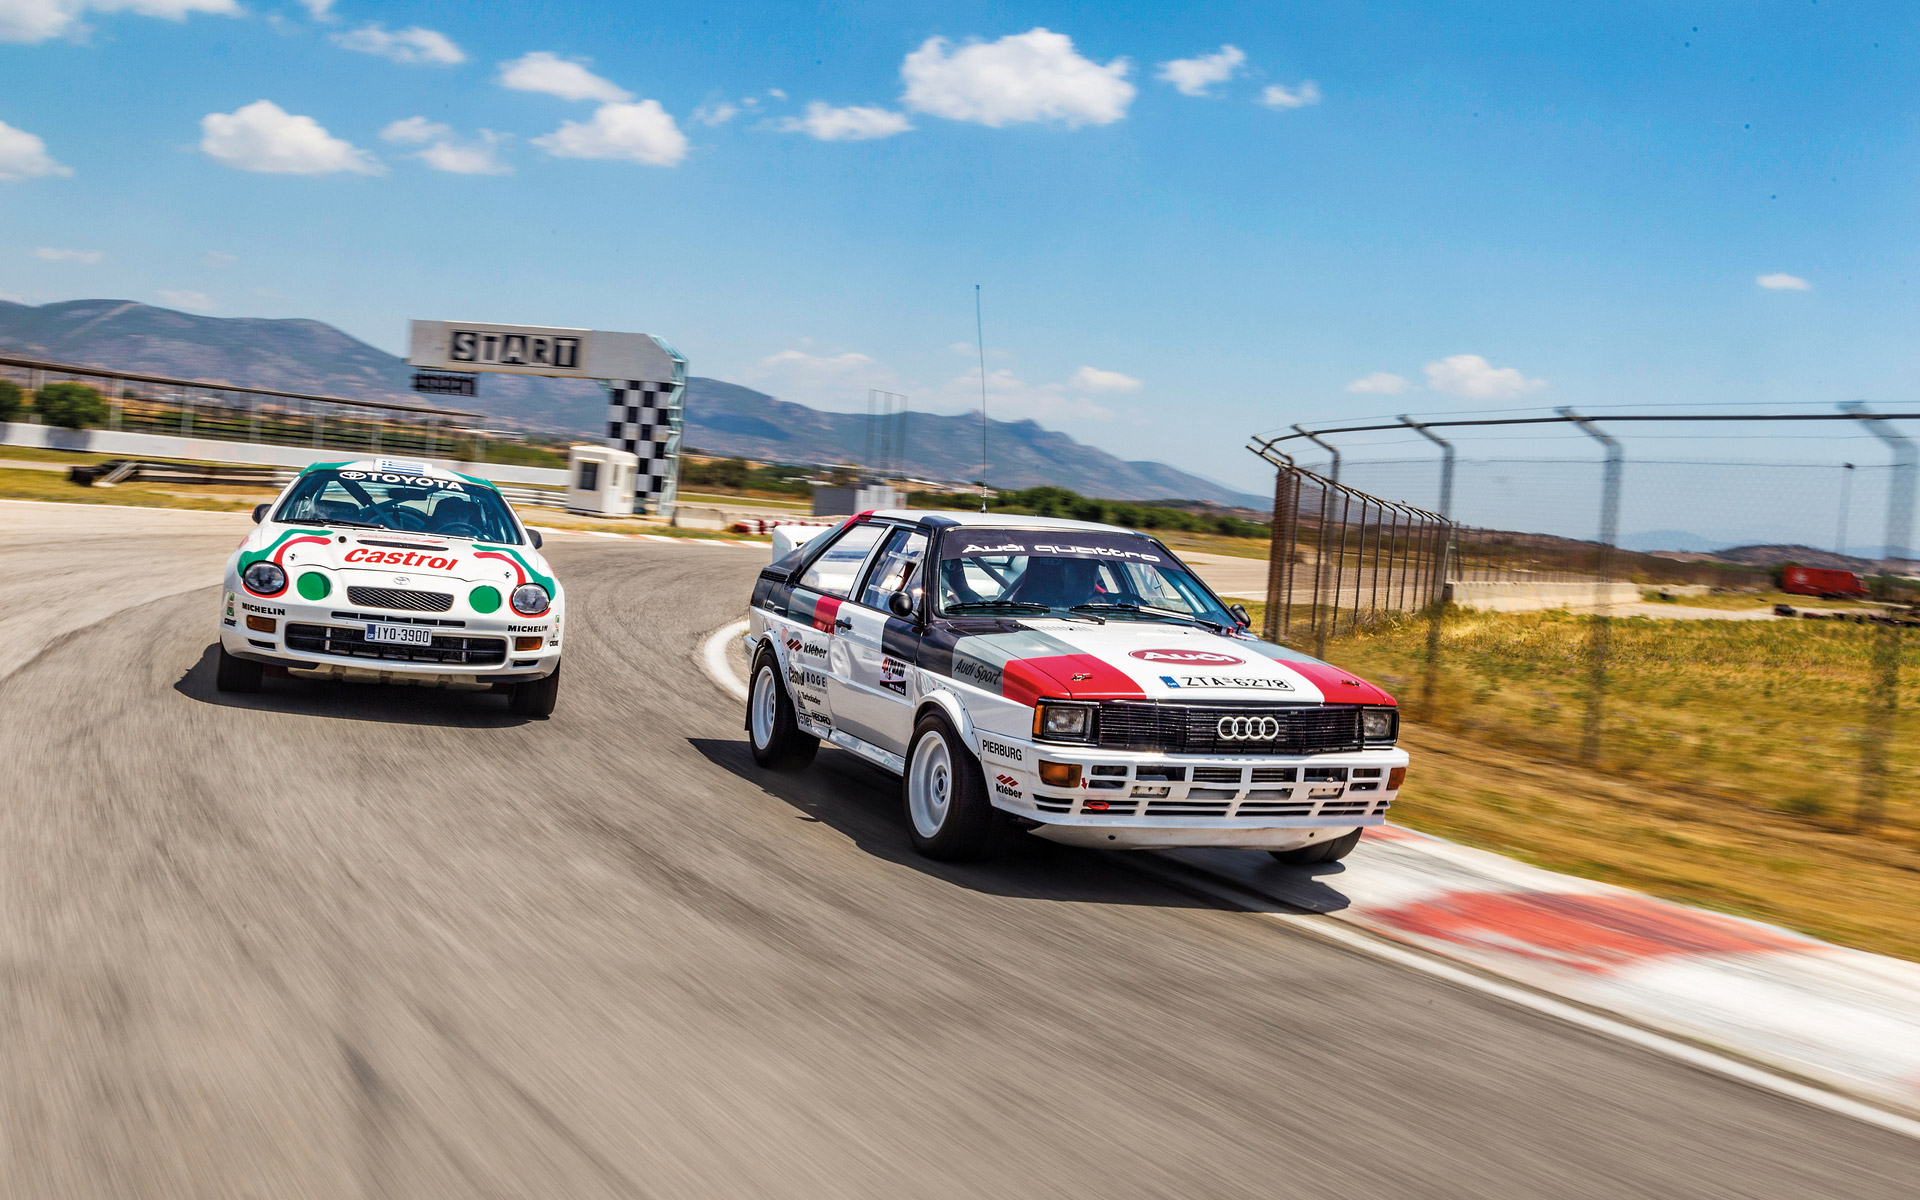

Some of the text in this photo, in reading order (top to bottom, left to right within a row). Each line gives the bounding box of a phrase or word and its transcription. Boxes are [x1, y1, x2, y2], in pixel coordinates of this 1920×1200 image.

[452, 331, 578, 367] START
[367, 472, 465, 492] TOYOTA
[344, 548, 458, 570] Castrol
[962, 544, 1160, 562] Audi quattro
[242, 602, 286, 616] MICHELIN
[377, 626, 430, 643] IYO-3900
[507, 625, 549, 633] MICHELIN
[1143, 651, 1236, 663] Audi
[806, 671, 826, 688] BOGE
[954, 659, 1002, 686] Audi Sport
[982, 739, 1023, 761] PIERBURG
